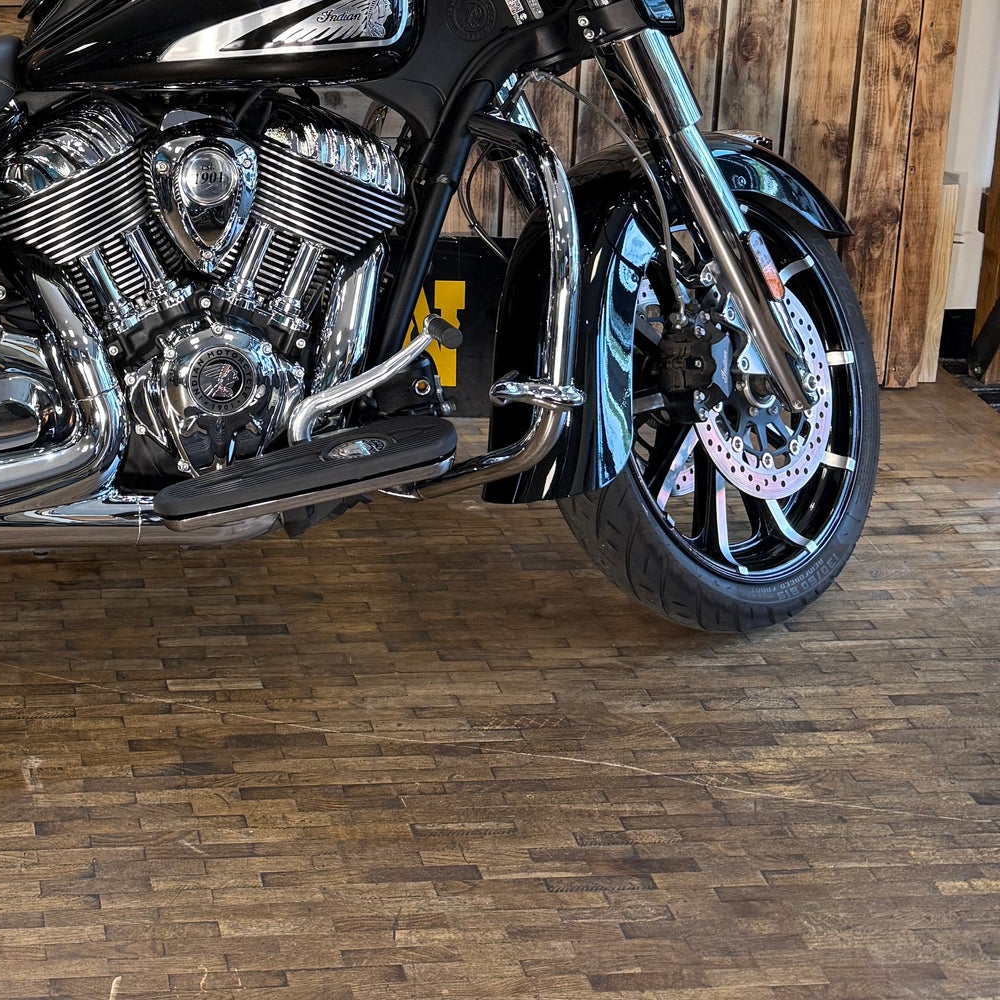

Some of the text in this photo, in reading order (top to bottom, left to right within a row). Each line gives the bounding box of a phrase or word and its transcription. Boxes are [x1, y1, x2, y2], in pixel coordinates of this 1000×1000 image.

[316, 9, 362, 23] Indian
[195, 171, 223, 185] 1901
[191, 349, 252, 400] INDIAN MOTORCYCLE
